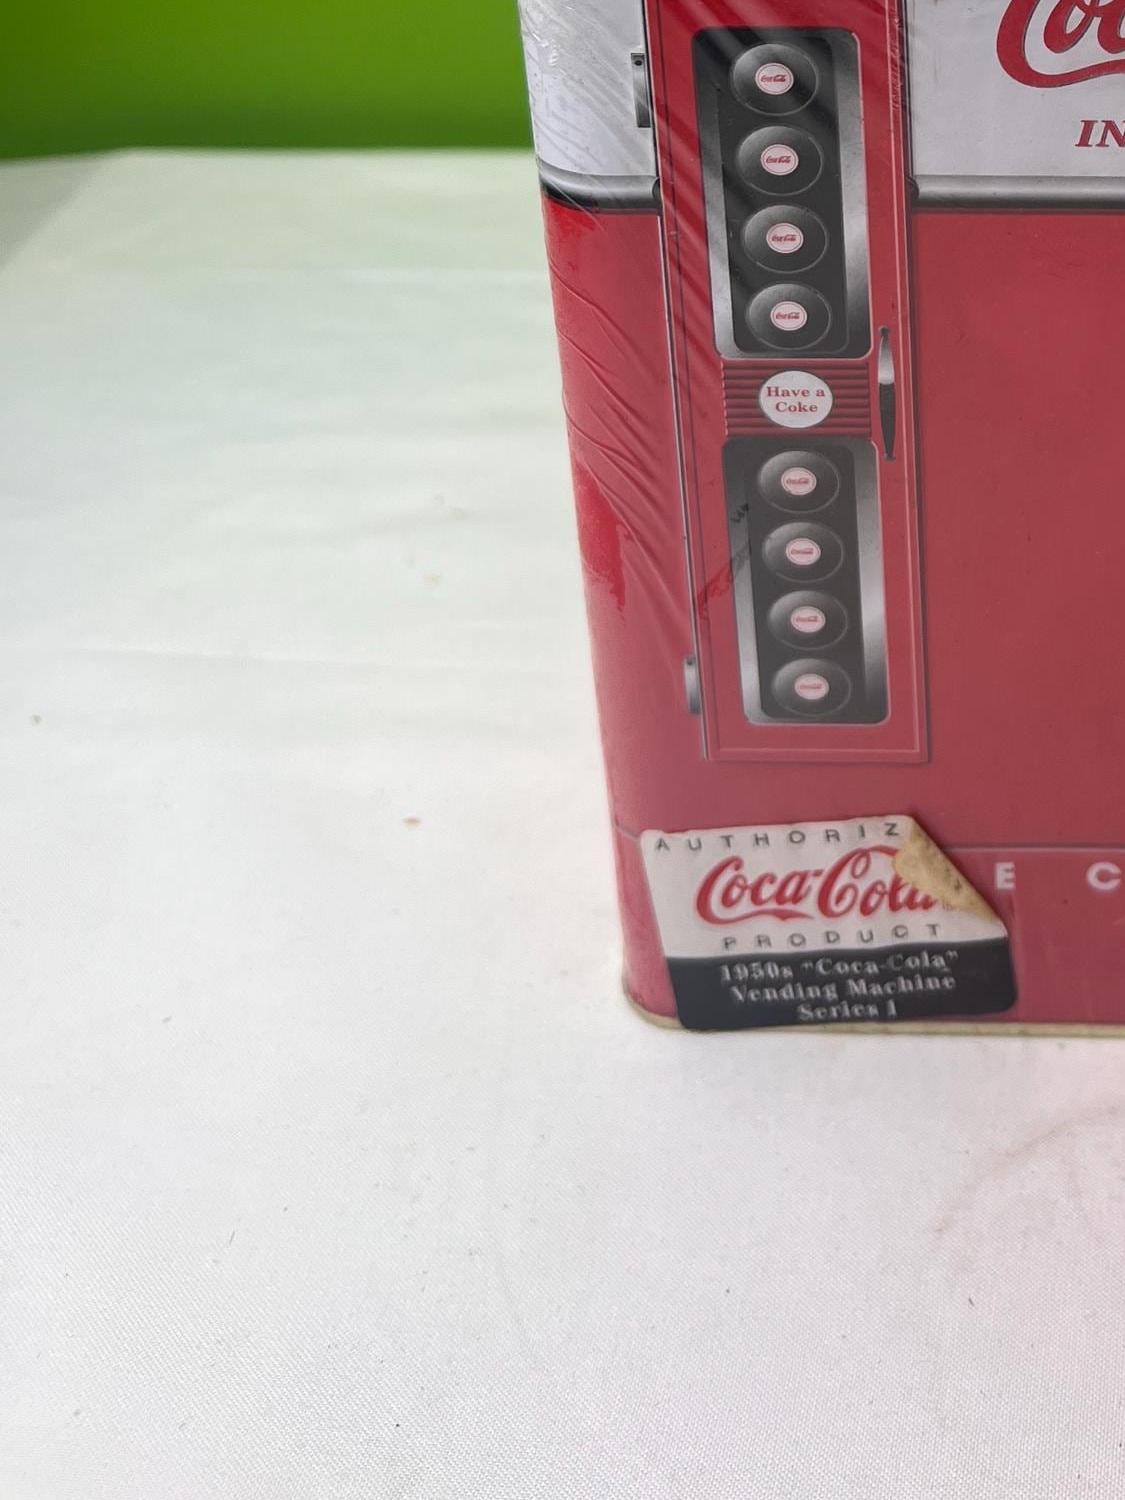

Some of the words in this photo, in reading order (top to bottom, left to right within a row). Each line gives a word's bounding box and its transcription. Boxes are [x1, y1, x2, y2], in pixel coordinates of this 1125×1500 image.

[766, 386, 810, 397] Have
[815, 388, 825, 397] a
[775, 401, 818, 412] Coke
[656, 822, 900, 852] AUTHORIZ
[723, 923, 941, 951] PRODUCT
[720, 961, 794, 982] 1950s
[730, 981, 839, 1002] Vending
[846, 973, 957, 997] Machine
[796, 1000, 880, 1021] Series
